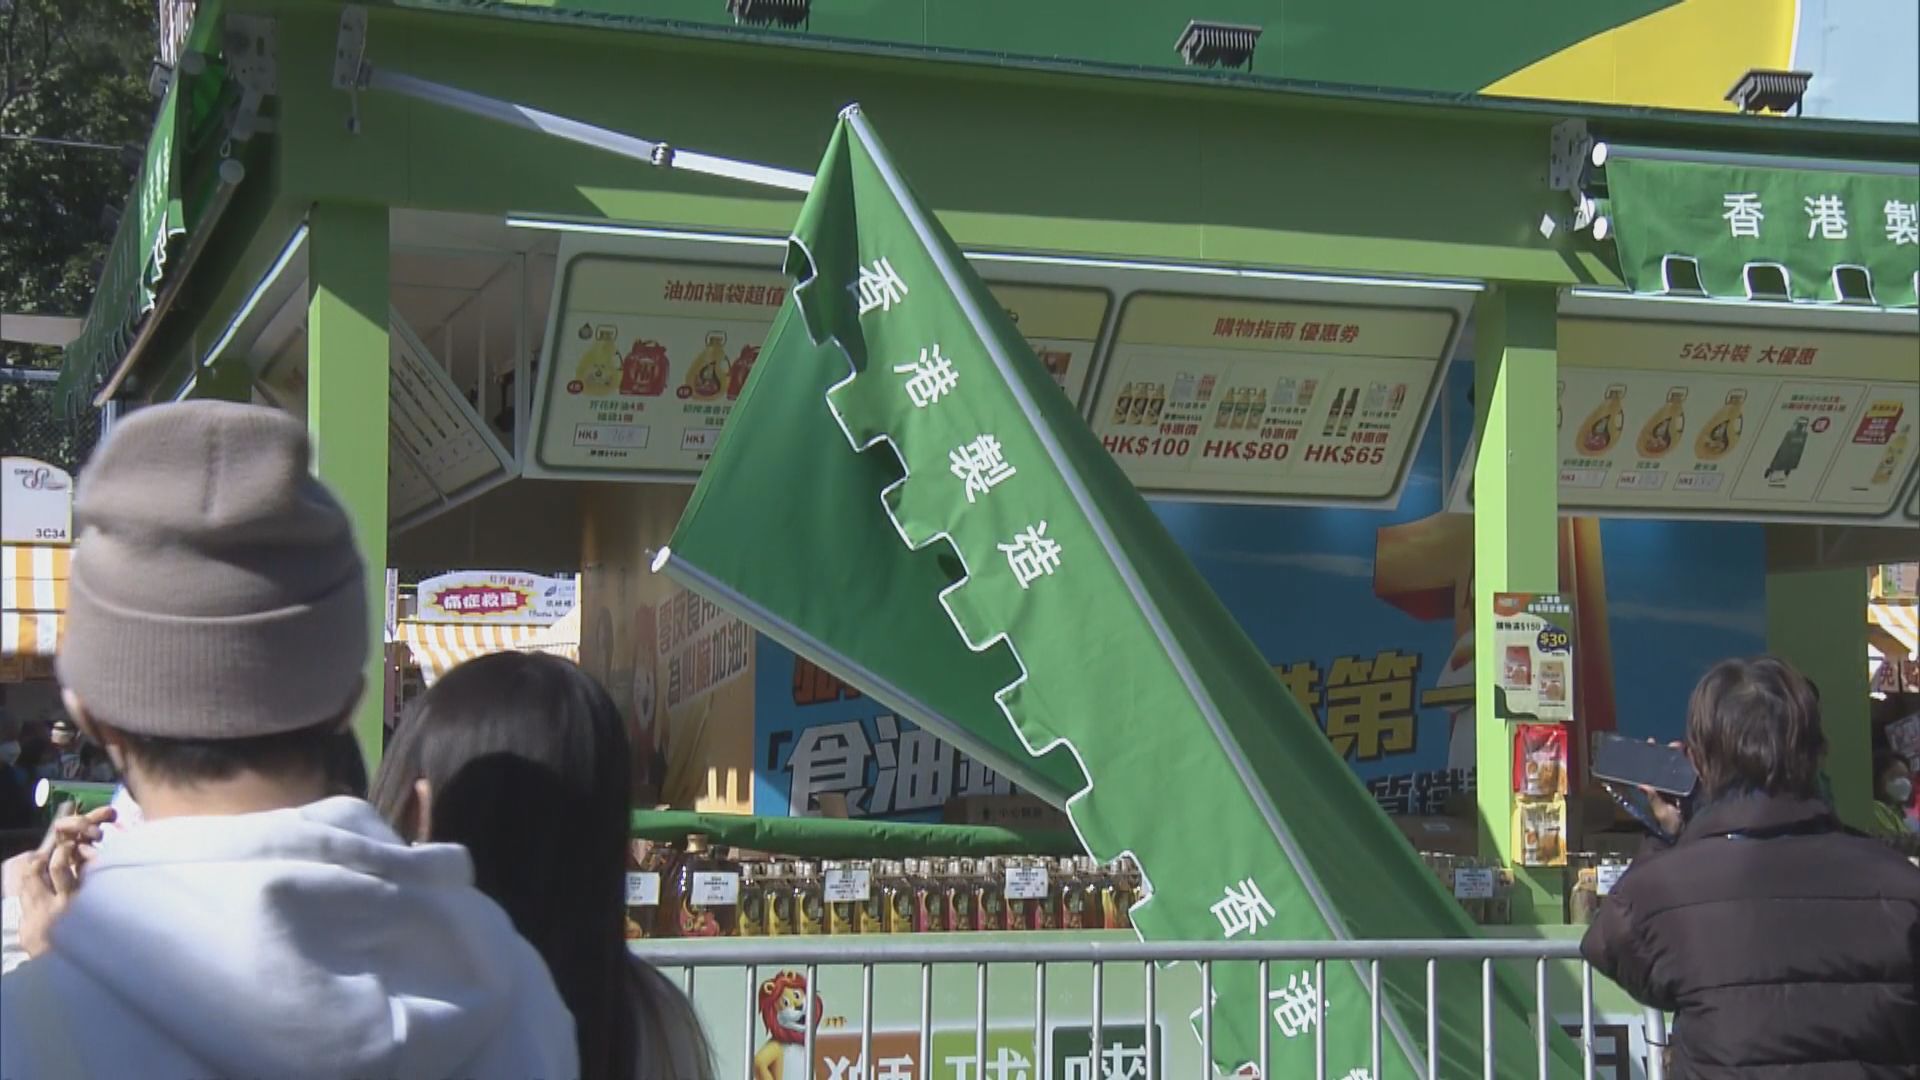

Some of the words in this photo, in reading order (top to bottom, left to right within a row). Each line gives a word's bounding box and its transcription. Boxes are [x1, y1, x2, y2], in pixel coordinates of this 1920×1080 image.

[1213, 317, 1295, 341] 購物指南
[1300, 322, 1359, 344] 優惠券
[1679, 344, 1751, 364] 5公升裝
[1757, 346, 1818, 366] 大優惠
[1103, 434, 1190, 457] HK$100
[1202, 439, 1289, 461] HK$80
[1304, 444, 1384, 465] HK$65
[36, 528, 66, 538] 3C34
